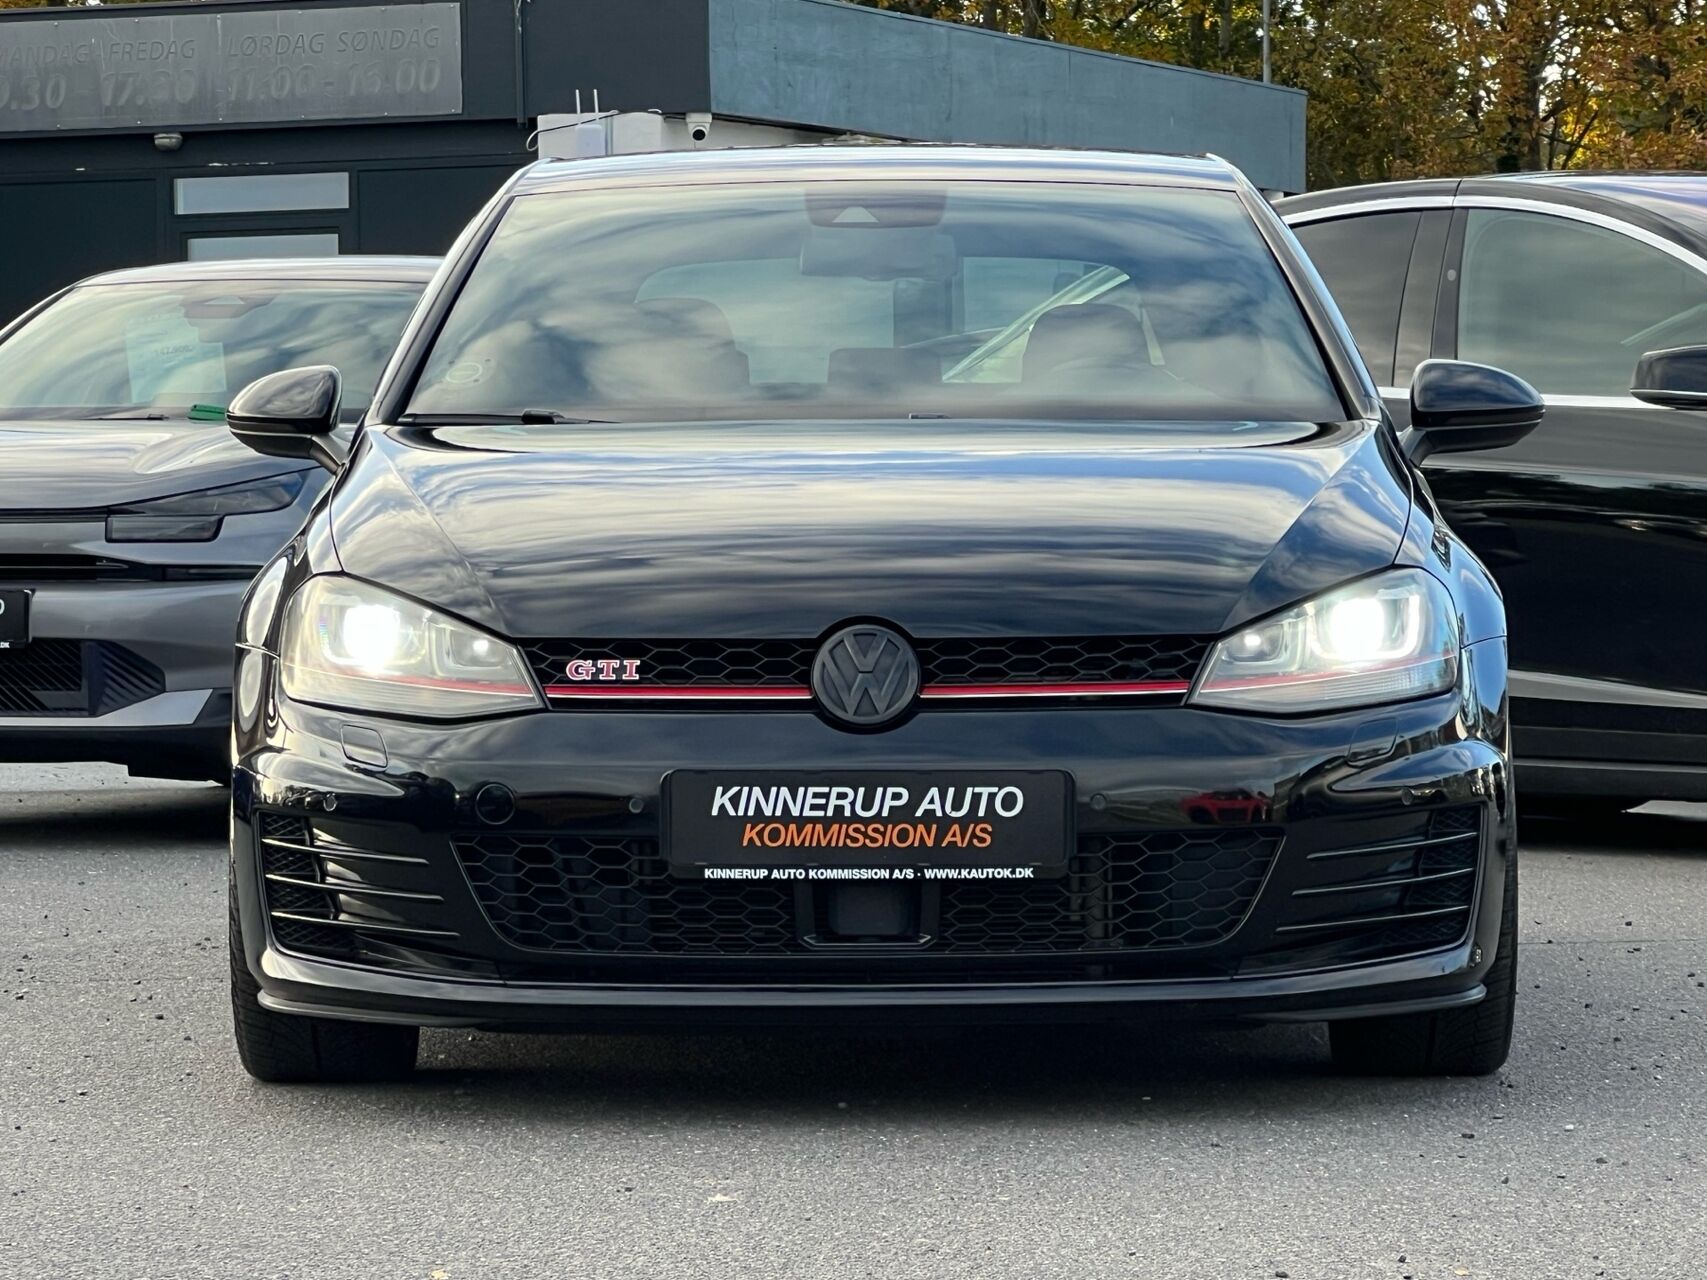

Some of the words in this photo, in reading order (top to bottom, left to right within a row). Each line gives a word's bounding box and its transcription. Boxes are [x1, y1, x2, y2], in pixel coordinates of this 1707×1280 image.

[108, 39, 196, 61] FREDAG
[227, 33, 325, 57] LØRDAG
[336, 28, 440, 53] SØNDAG
[566, 659, 641, 681] GTI
[711, 786, 909, 817] KINNERUP
[915, 786, 1024, 817] AUTO
[742, 823, 938, 848] KOMMISSION
[941, 823, 993, 848] A/S
[704, 868, 768, 879] KINNERUP
[771, 868, 805, 879] AUTO
[809, 868, 890, 879] KOMMISSION
[892, 868, 914, 879] A/S
[924, 867, 1034, 879] WWW.KAUTOK.DK
